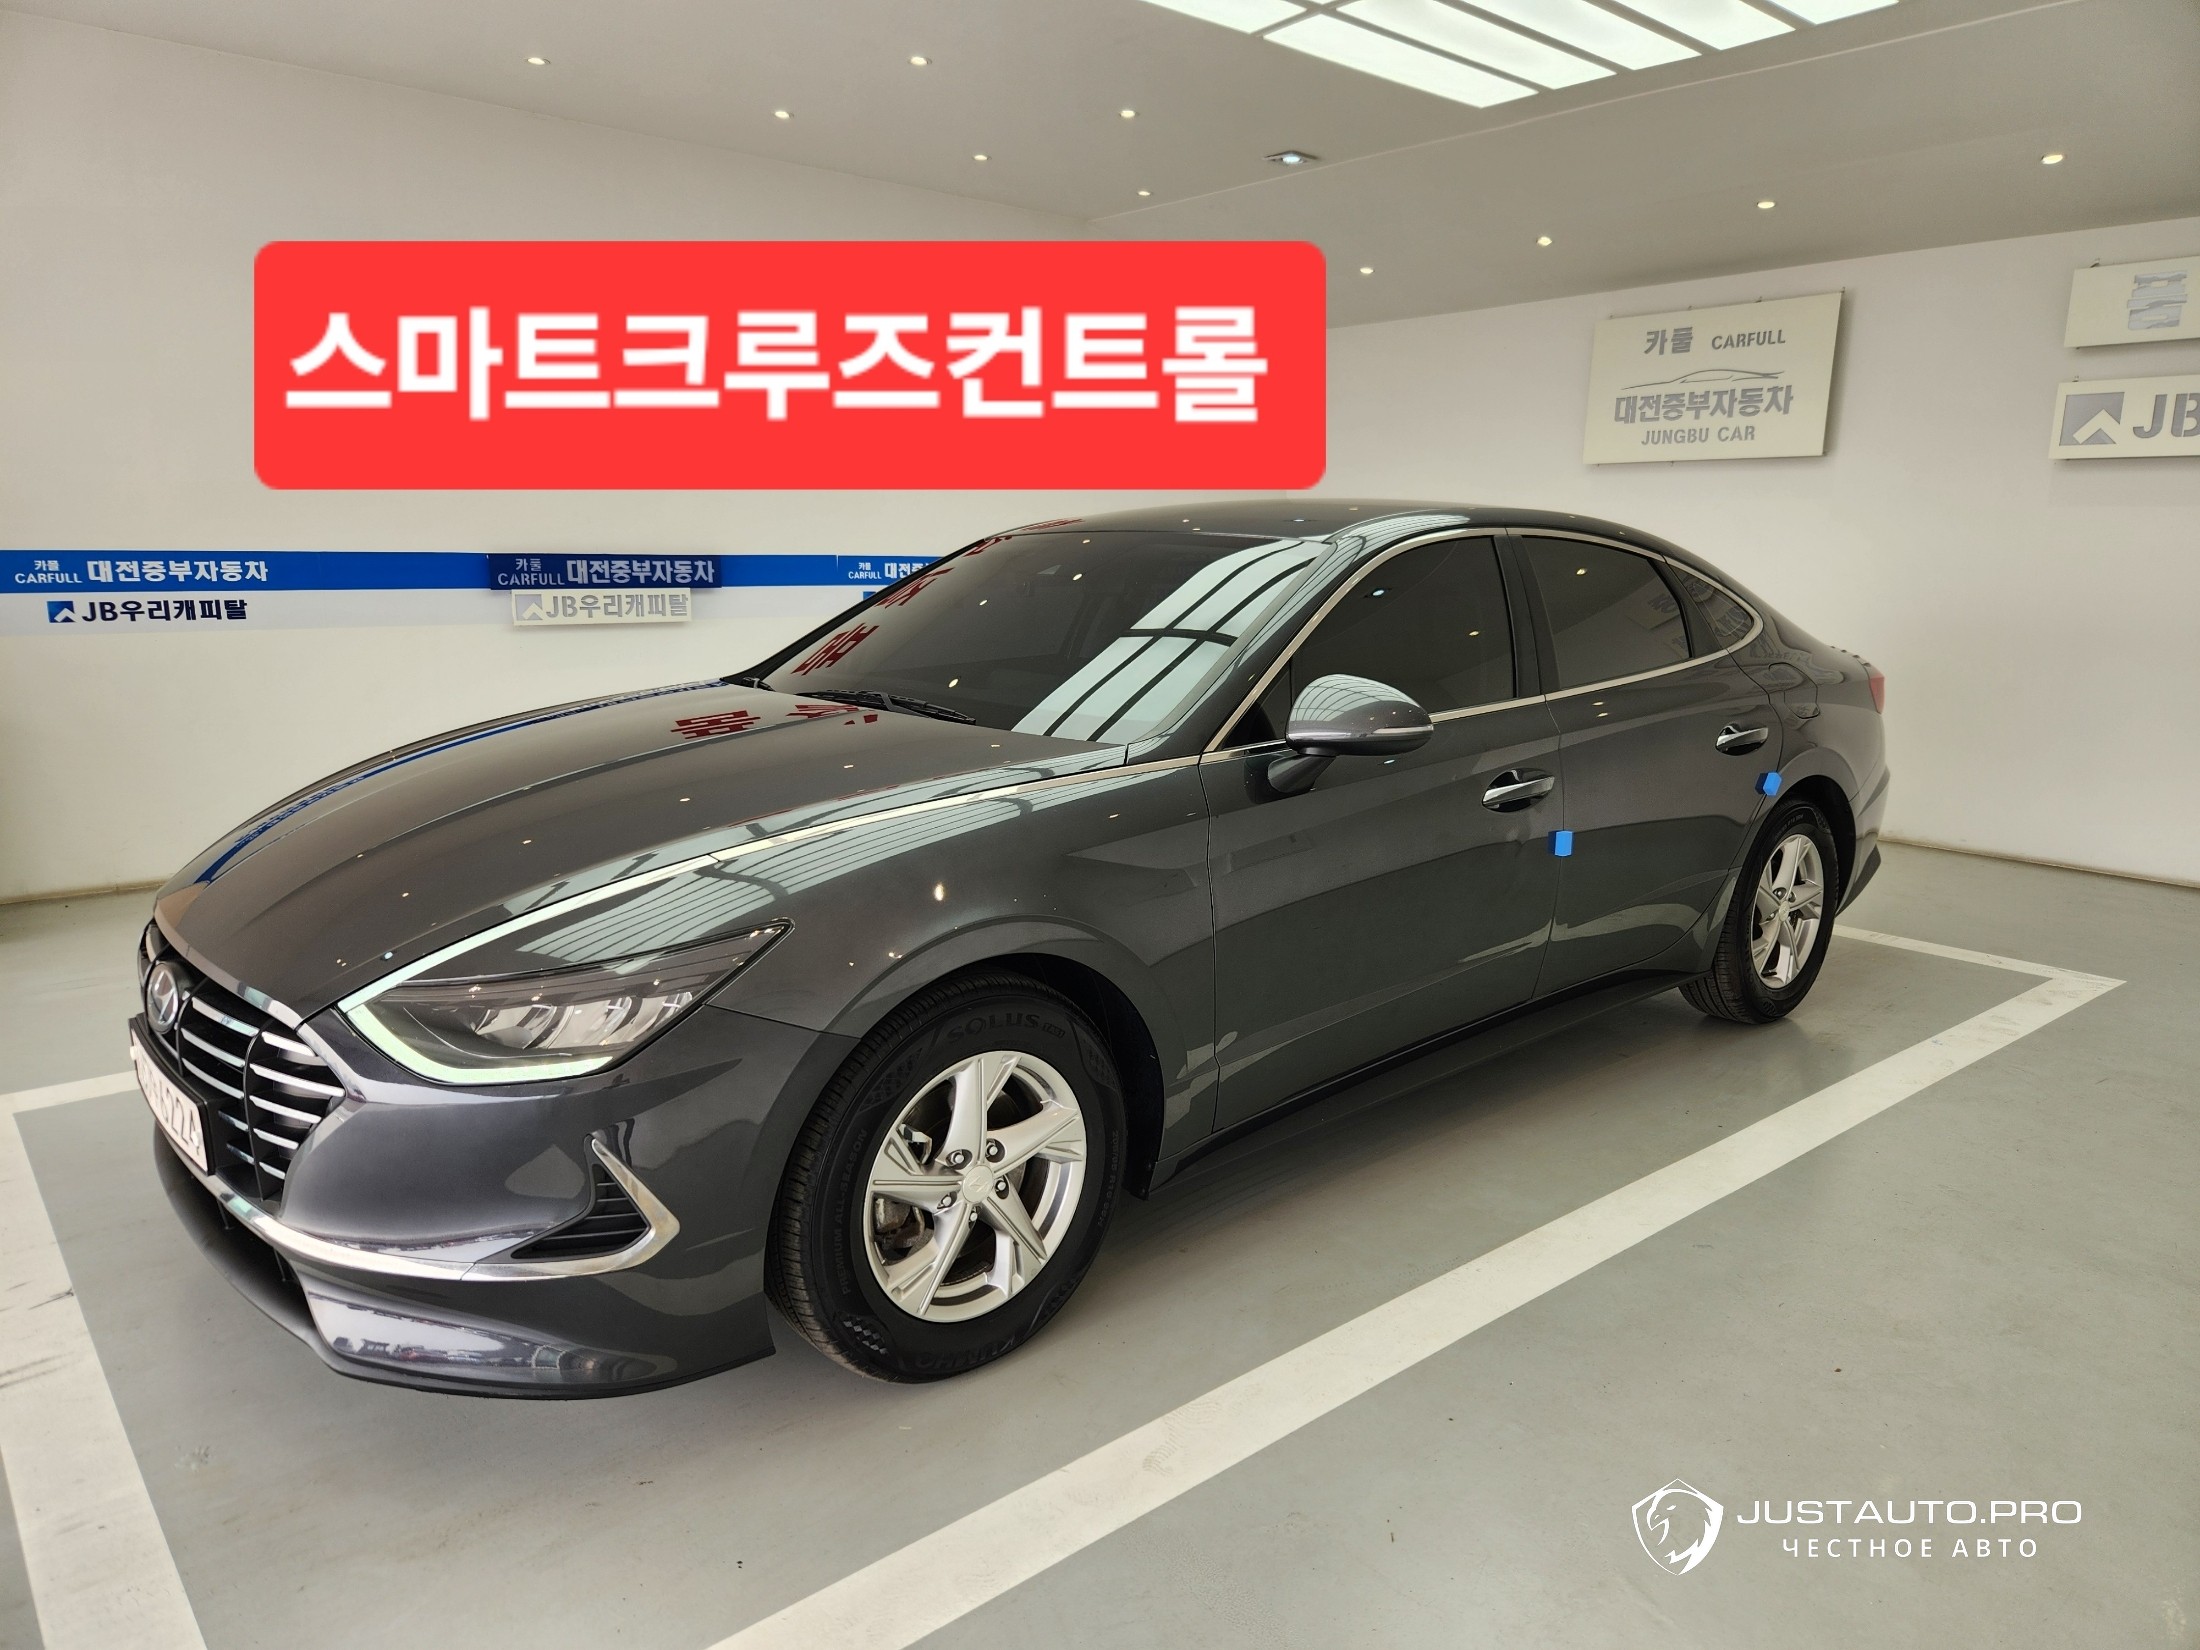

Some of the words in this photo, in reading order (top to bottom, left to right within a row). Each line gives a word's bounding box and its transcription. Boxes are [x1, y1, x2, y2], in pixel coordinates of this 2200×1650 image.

[1644, 326, 1694, 356] 카풀
[1711, 329, 1786, 350] CARFULL
[1614, 384, 1794, 424] 대전중부자동차
[1641, 427, 1710, 445] JUNGBU
[1717, 425, 1756, 442] CAR
[86, 559, 269, 583] 대전중부자동차
[515, 558, 542, 572] 카풀
[566, 559, 715, 585] 대전중부자동차
[848, 571, 882, 580] CARFULL
[14, 572, 82, 584] CARFULL
[497, 572, 565, 586] CARFULL
[82, 599, 248, 622] JB우리캐피탈
[546, 593, 689, 619] JB우리캐피탈
[947, 1012, 1040, 1044] SOLUS
[834, 1127, 868, 1225] ALL-SEASON
[833, 1228, 852, 1296] PREMIUM
